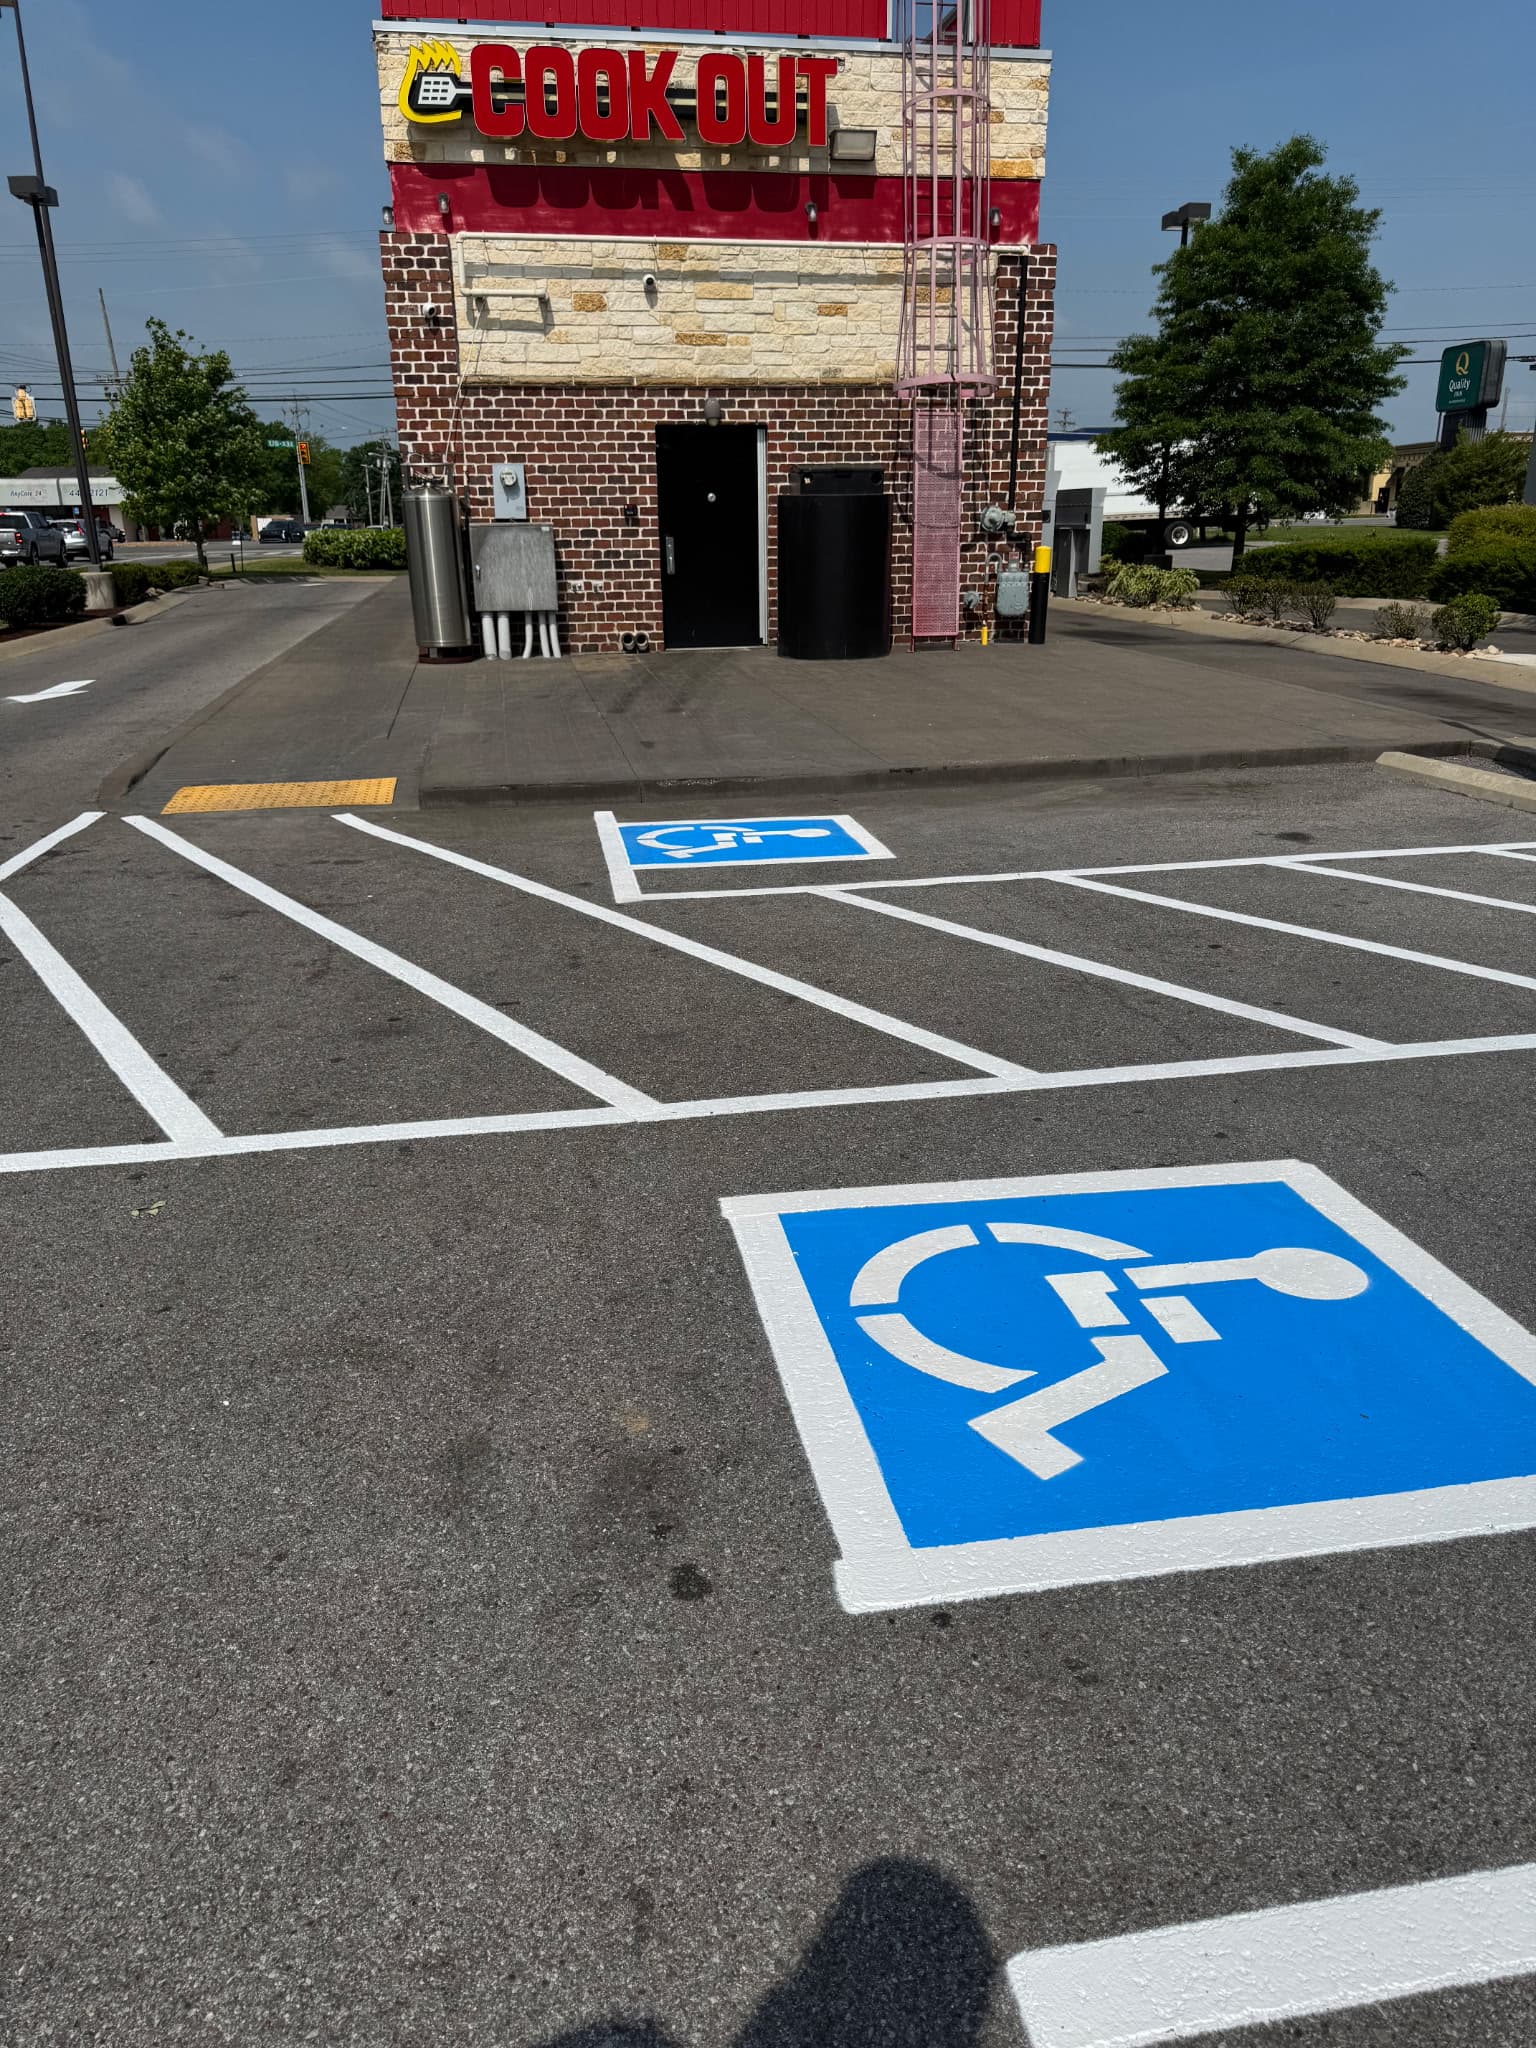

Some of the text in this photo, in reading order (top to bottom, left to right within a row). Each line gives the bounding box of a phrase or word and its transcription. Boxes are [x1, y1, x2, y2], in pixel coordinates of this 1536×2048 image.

[470, 43, 838, 147] COOK OUT
[1456, 351, 1469, 375] Q
[1449, 378, 1471, 392] Quality
